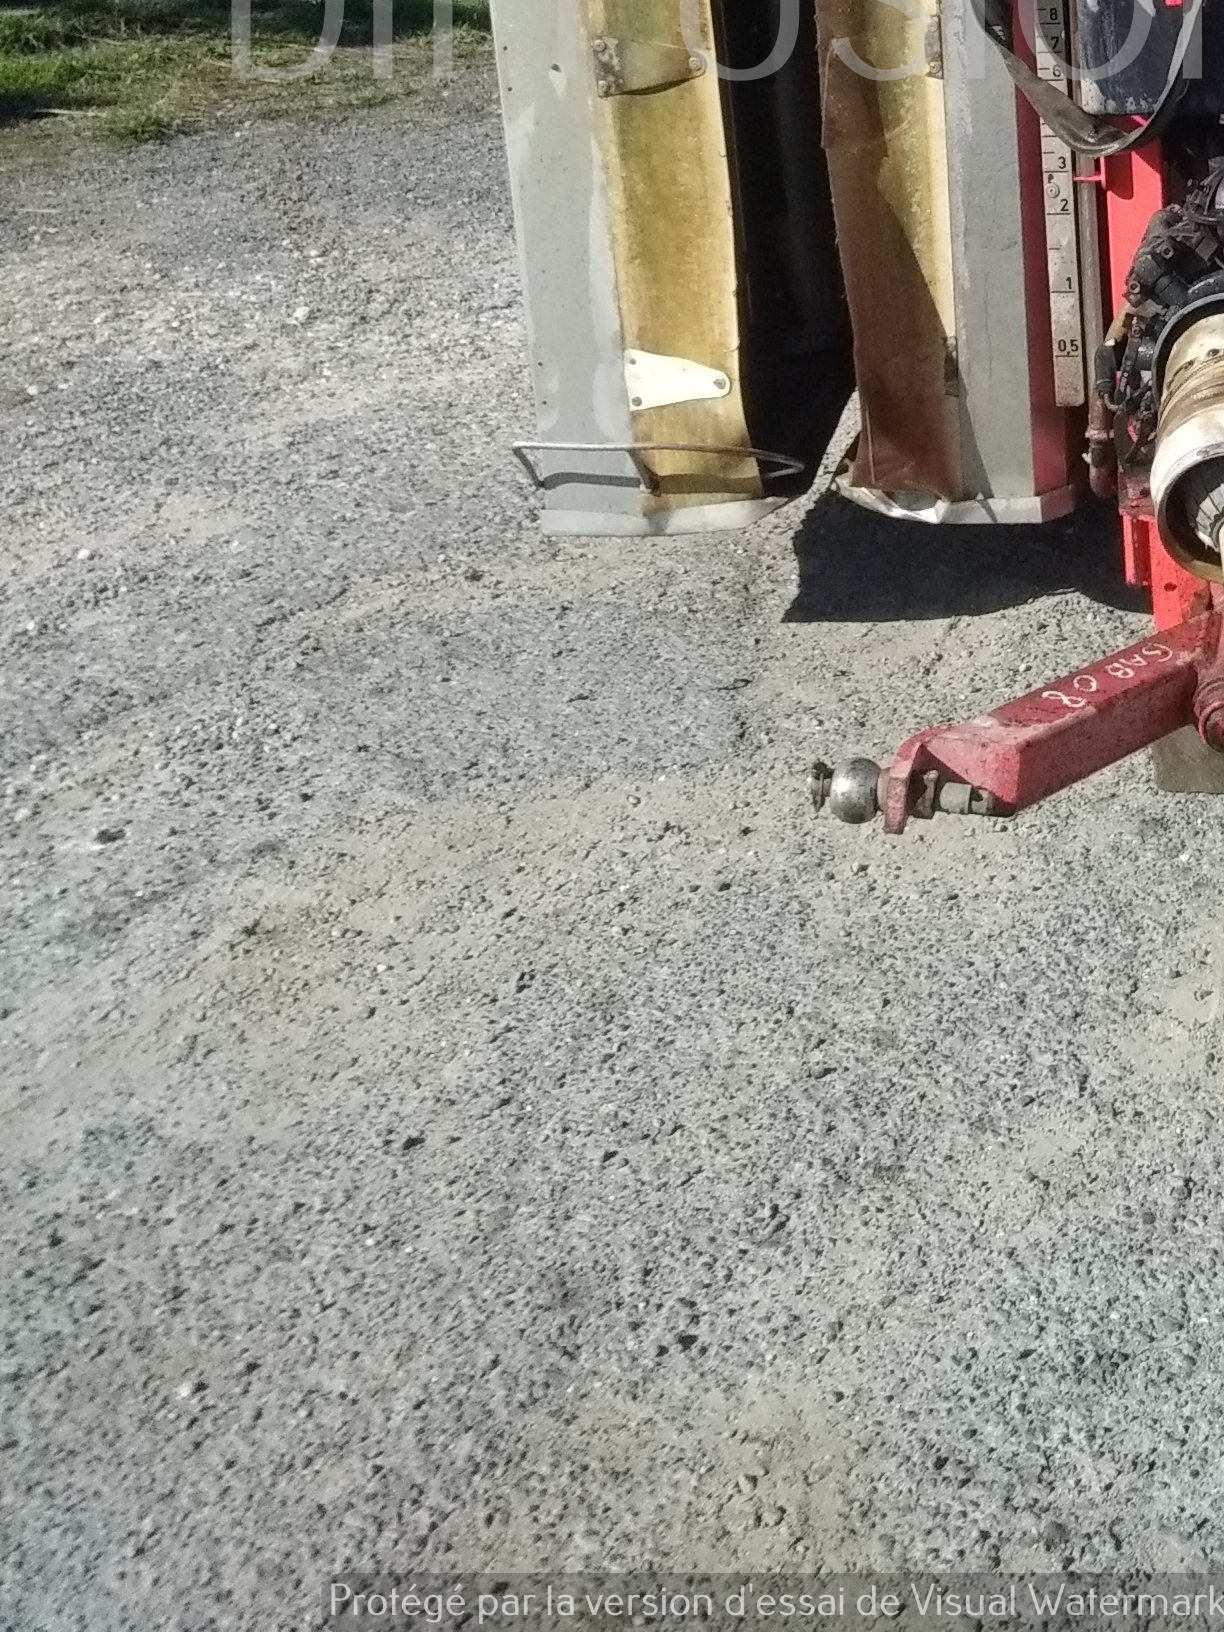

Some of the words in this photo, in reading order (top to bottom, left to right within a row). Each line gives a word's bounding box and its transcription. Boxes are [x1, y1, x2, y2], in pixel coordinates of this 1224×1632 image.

[1049, 7, 1058, 21] 8
[1050, 35, 1060, 50] 7
[1052, 64, 1062, 78] 6
[1058, 156, 1067, 169] 3
[1060, 198, 1069, 212] 2
[1065, 277, 1073, 290] 1
[1057, 340, 1079, 356] 0,5
